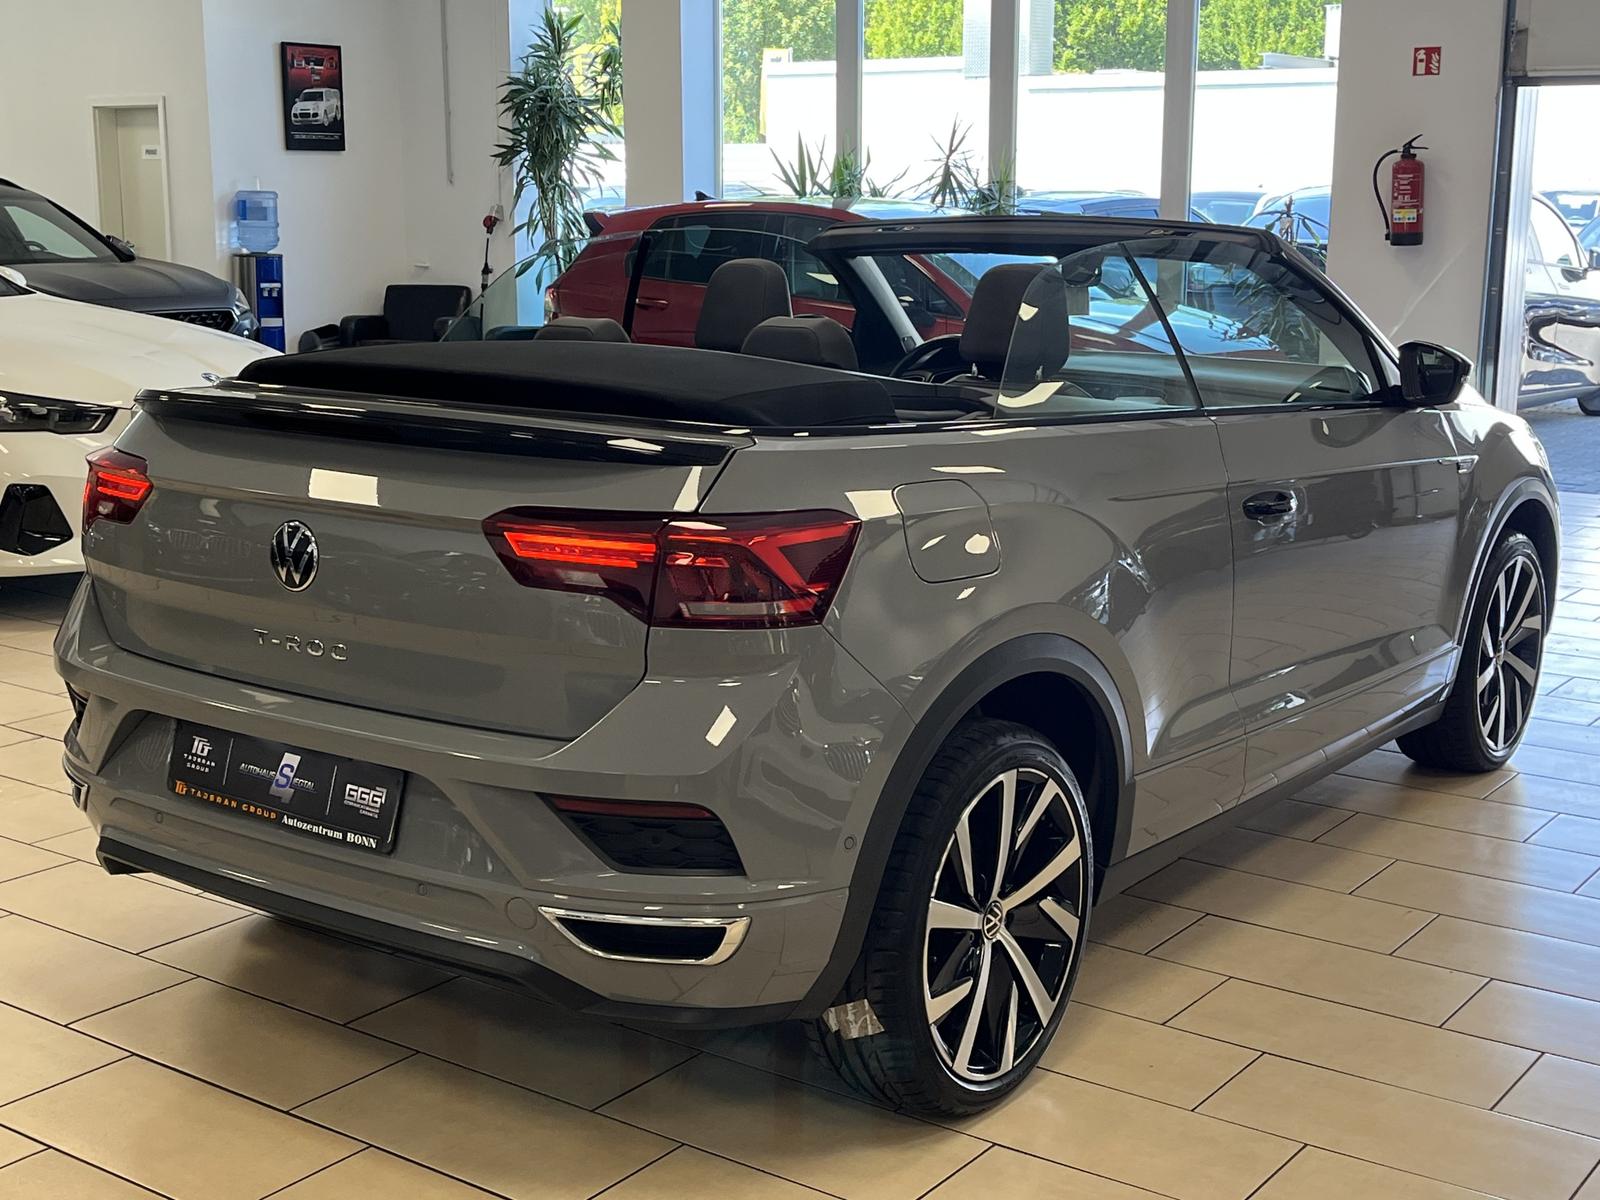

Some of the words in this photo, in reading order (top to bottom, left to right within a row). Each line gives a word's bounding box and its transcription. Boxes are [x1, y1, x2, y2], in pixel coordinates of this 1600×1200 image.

[272, 521, 318, 591] VW
[253, 628, 348, 661] T-ROC
[240, 763, 277, 779] AUTOHAUS
[281, 814, 343, 840] Autozentrum
[346, 832, 377, 849] BONN
